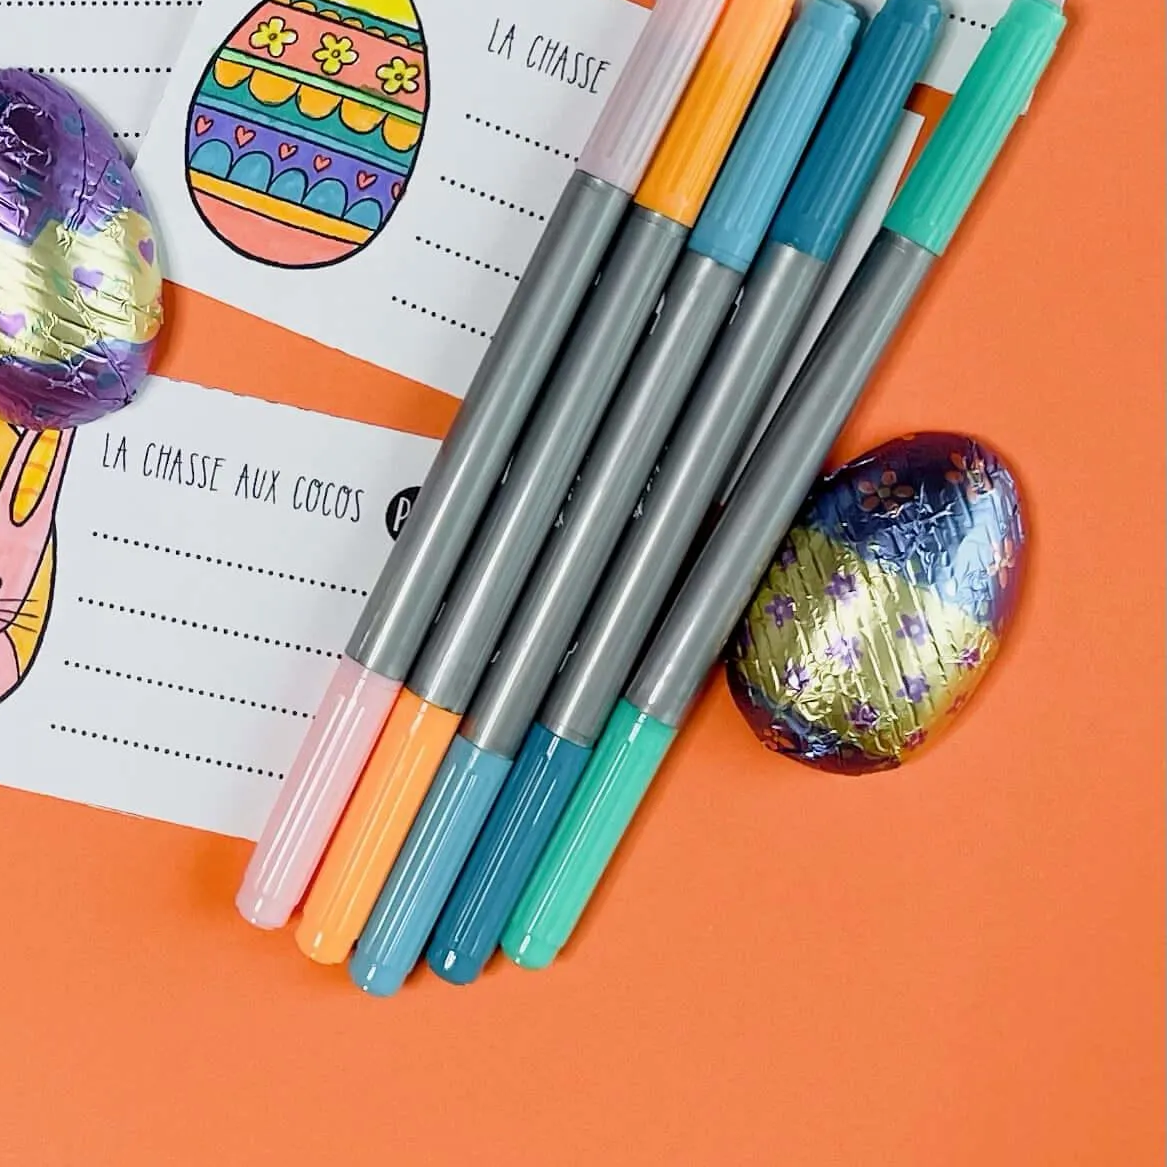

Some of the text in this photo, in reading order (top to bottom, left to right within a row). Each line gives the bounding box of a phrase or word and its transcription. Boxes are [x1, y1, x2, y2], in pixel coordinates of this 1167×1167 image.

[488, 18, 610, 93] LA CHASSE
[103, 433, 127, 472] LA
[143, 443, 225, 491] CHASSE
[235, 464, 280, 504] AUX
[293, 476, 364, 522] COCOS
